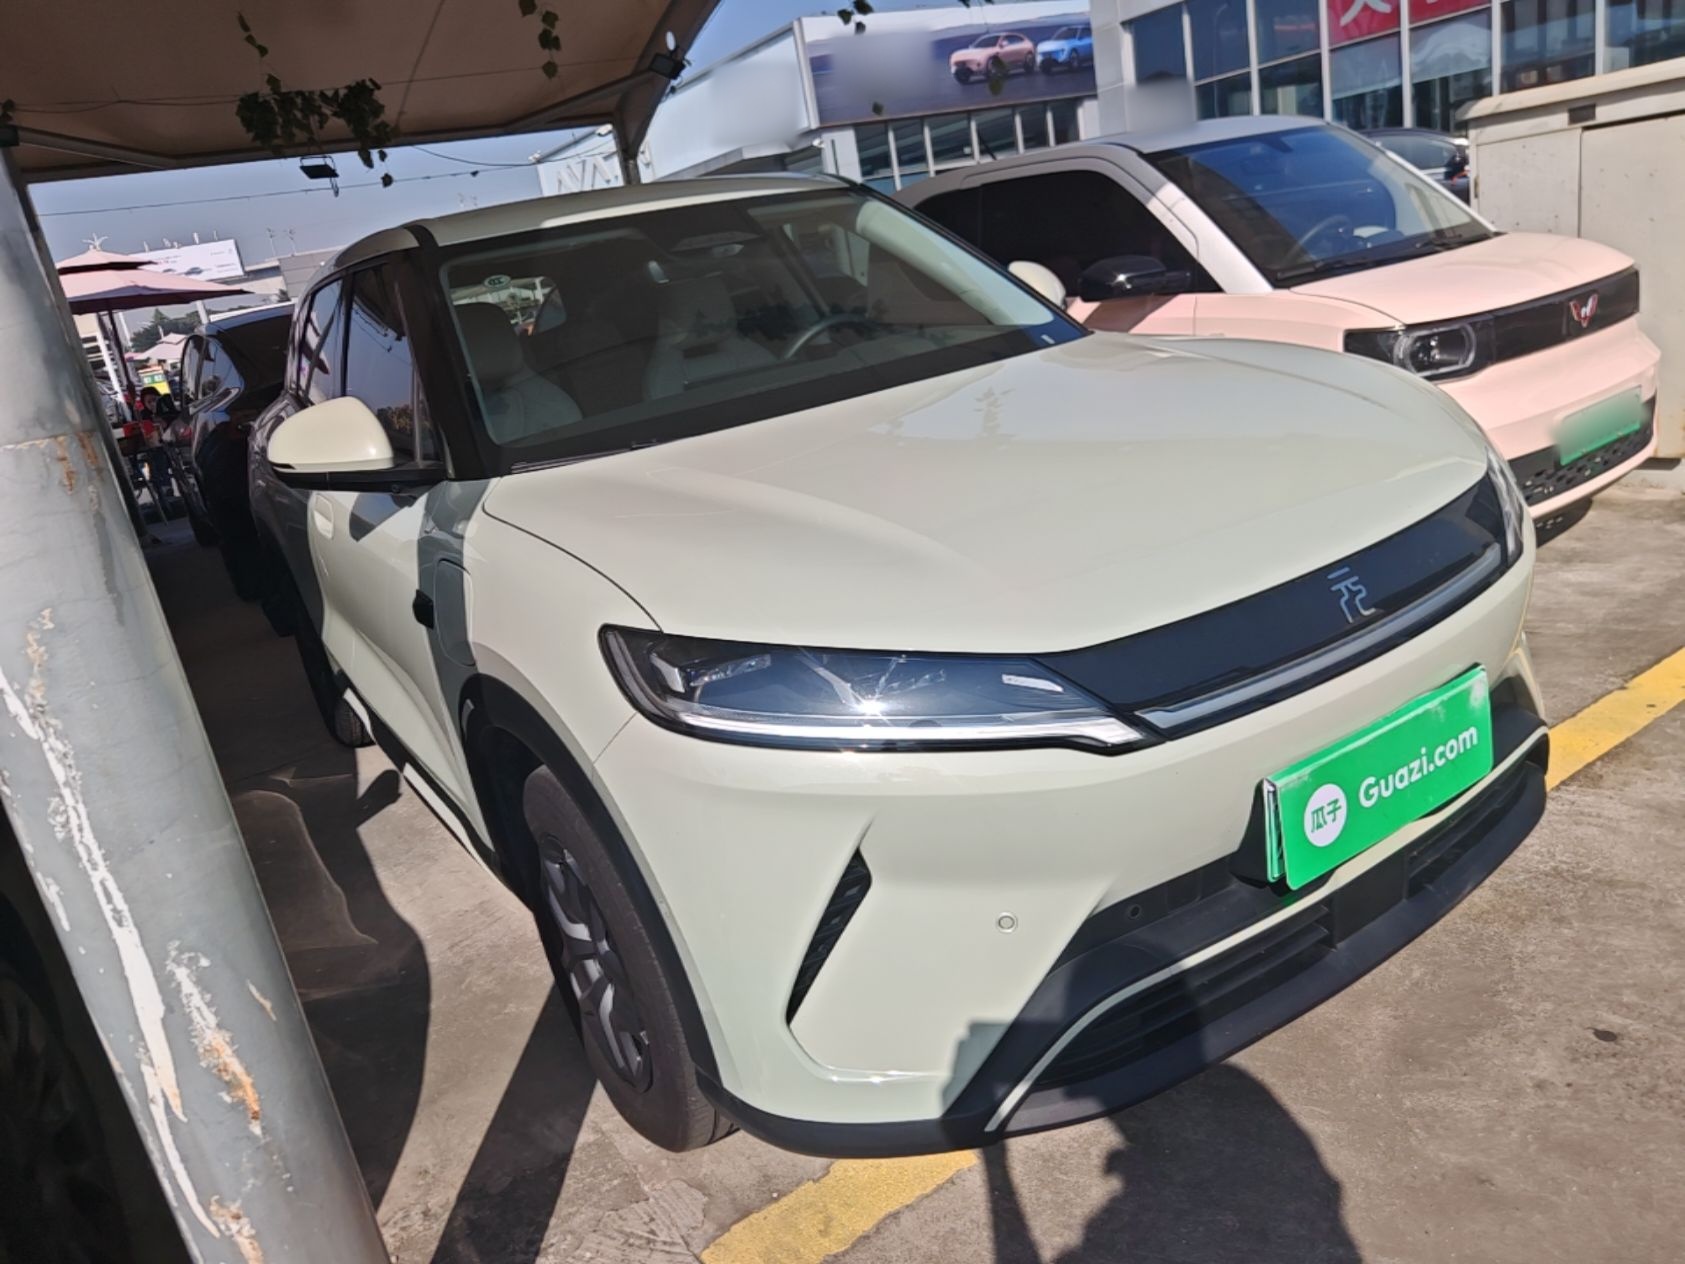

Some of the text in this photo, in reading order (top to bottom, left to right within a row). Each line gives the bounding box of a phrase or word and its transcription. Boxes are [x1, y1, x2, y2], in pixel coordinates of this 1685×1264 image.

[1327, 566, 1376, 624] 元
[1310, 726, 1478, 833] 瓜子 Guazi.com
